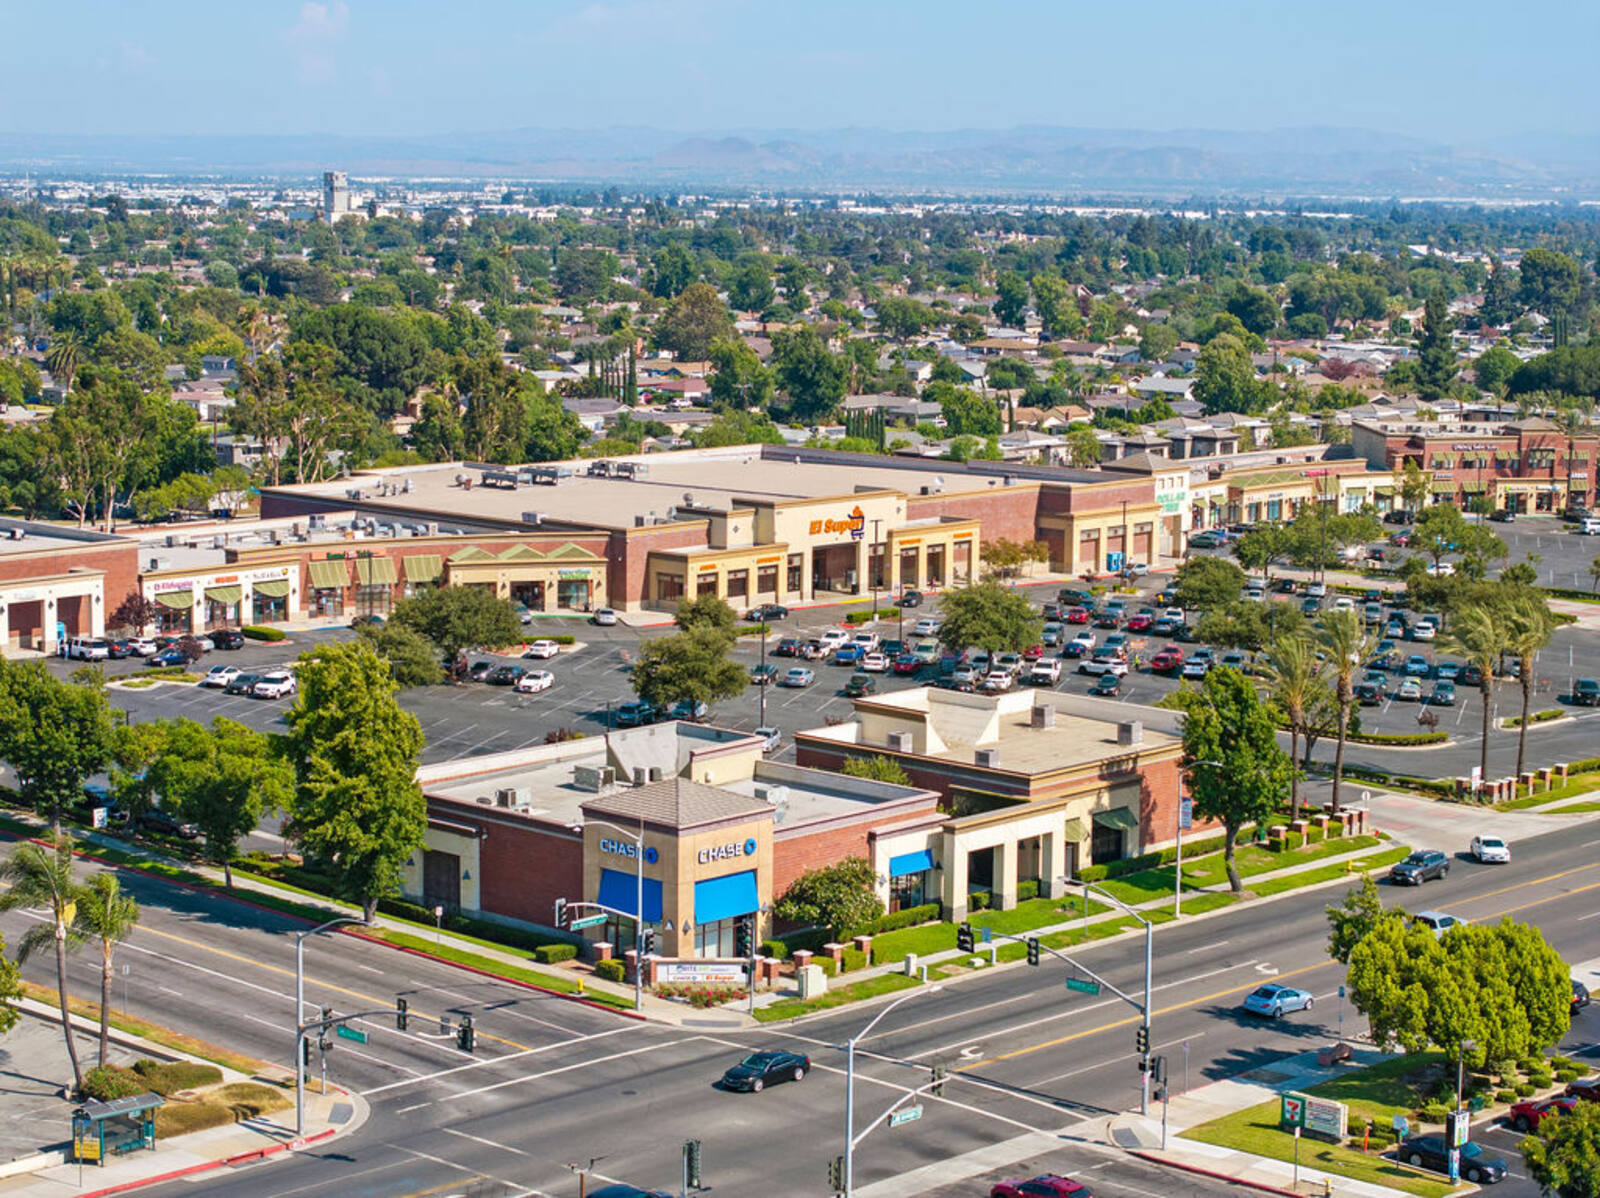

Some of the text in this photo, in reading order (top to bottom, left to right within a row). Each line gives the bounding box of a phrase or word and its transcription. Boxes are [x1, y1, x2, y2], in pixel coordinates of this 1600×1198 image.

[810, 518, 863, 535] El Super
[699, 842, 743, 863] CHASE
[1287, 1101, 1299, 1111] 7
